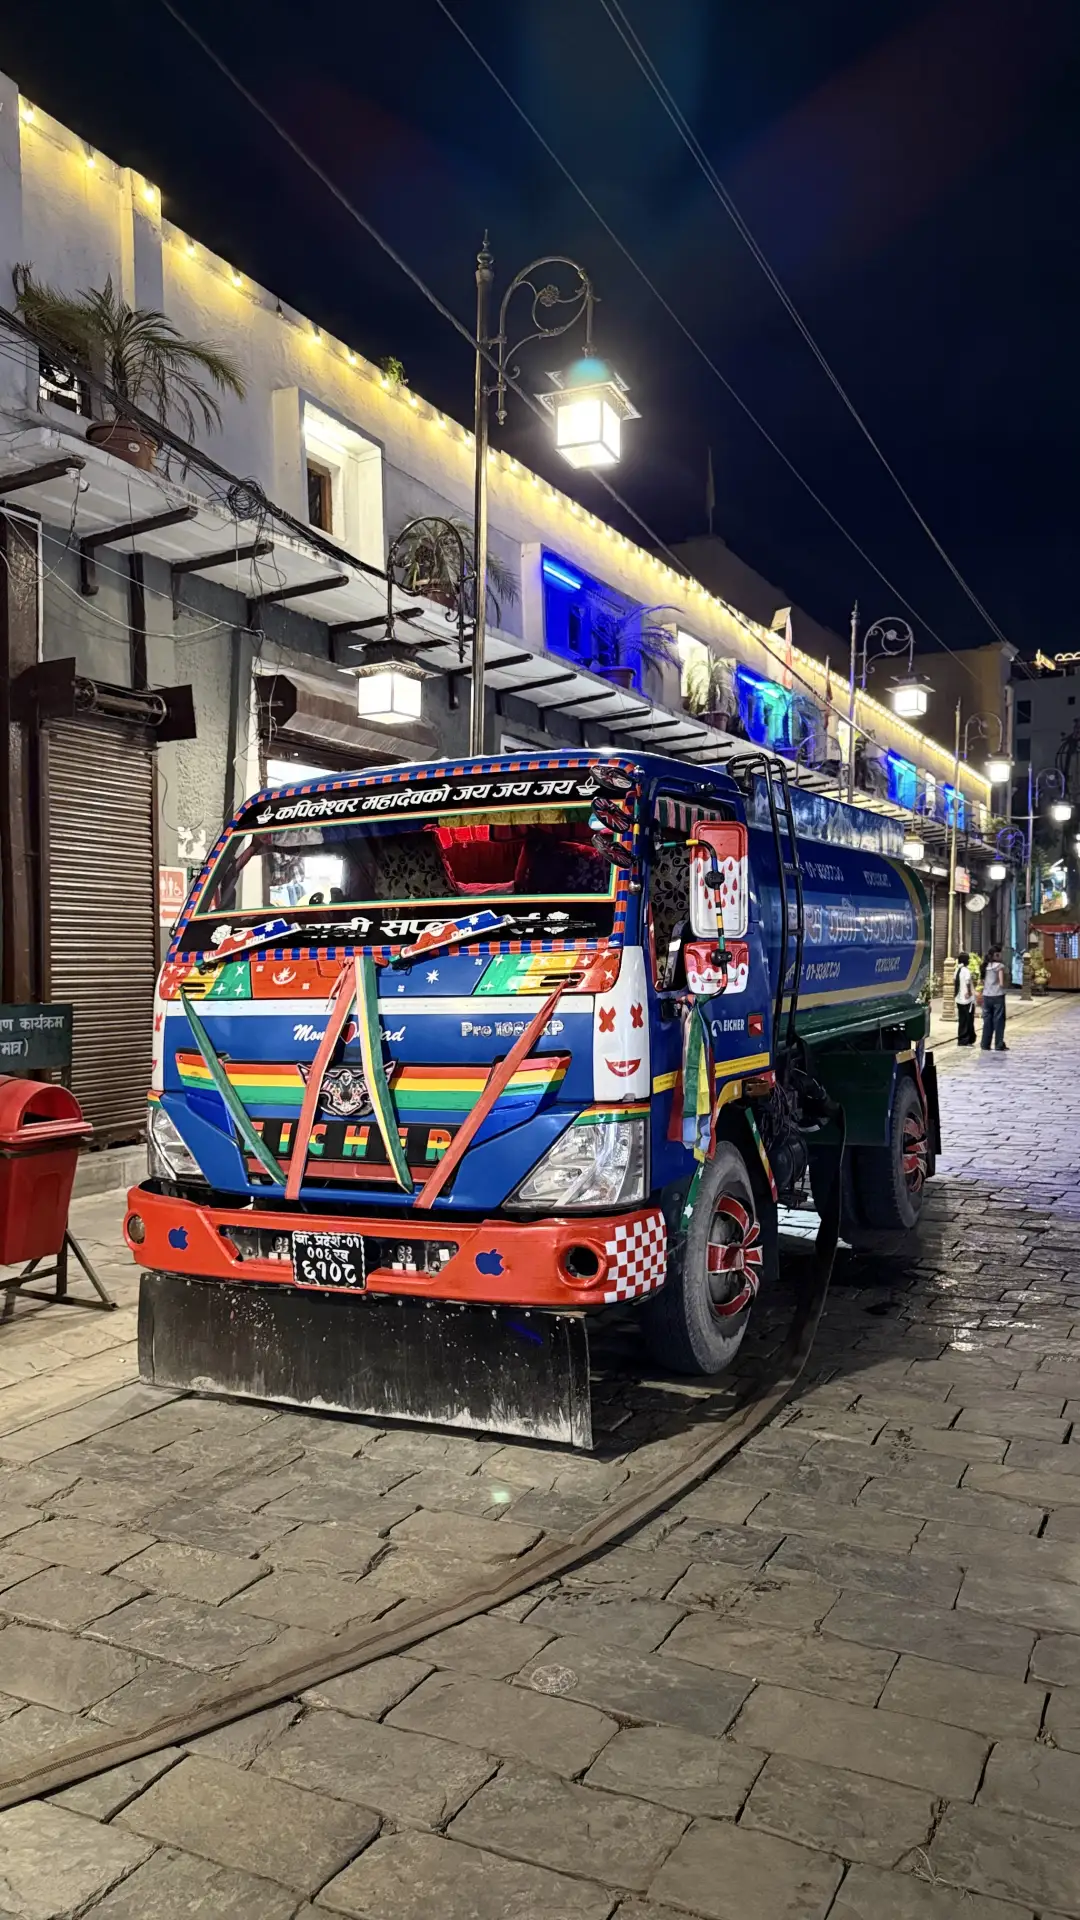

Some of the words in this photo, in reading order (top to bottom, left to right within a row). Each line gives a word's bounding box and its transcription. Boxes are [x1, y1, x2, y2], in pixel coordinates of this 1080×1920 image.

[275, 799, 361, 820] कपिलेश्वर
[362, 784, 453, 810] महादेवको
[453, 784, 493, 800] जय
[493, 781, 535, 798] जय
[533, 779, 577, 795] जय
[19, 1014, 64, 1030] कार्यक्रम
[461, 1021, 492, 1037] Pro
[723, 1018, 745, 1032] EICHER
[301, 1260, 357, 1285] ६१०८
